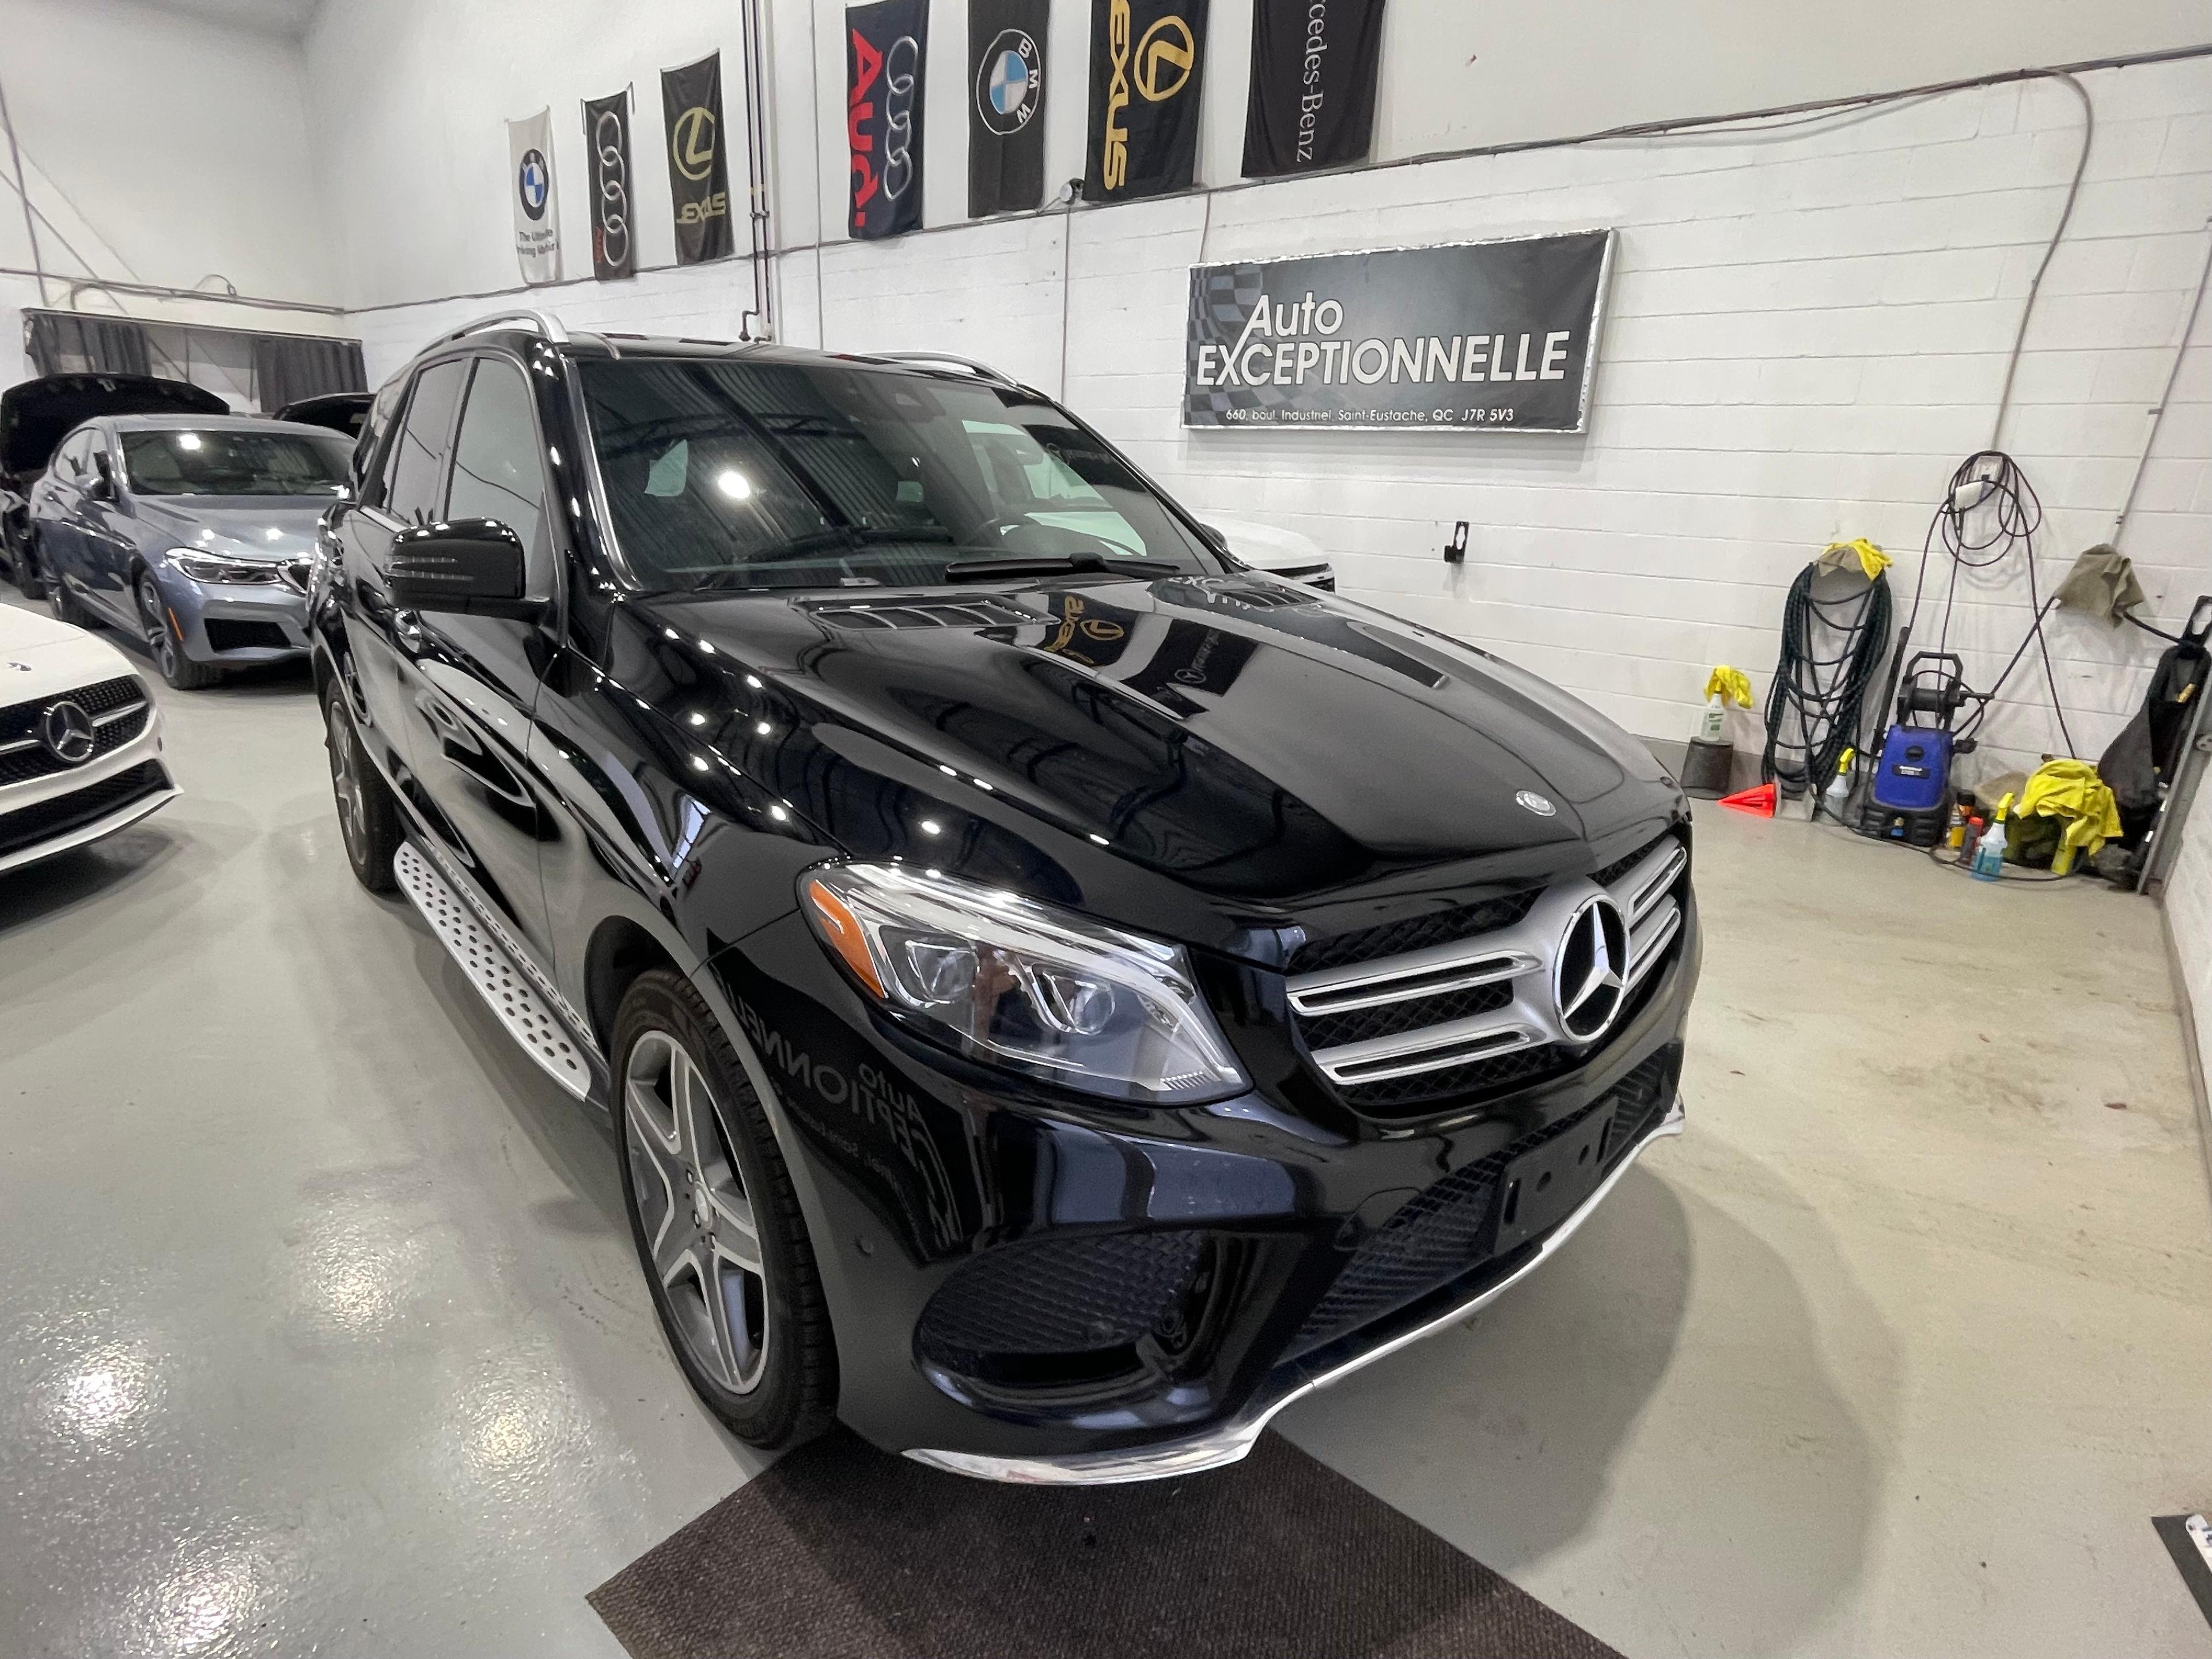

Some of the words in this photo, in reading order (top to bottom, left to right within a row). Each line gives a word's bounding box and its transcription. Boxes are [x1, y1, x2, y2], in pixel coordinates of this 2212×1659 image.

[1017, 37, 1038, 124] BMW
[1104, 0, 1130, 190] EXUS
[1297, 0, 1328, 162] cedes-Benz
[1238, 292, 1343, 344] Auto
[1196, 331, 1570, 386] EXCEPTIONNELLE
[1338, 408, 1429, 422] Saint-Eustache,
[1433, 408, 1454, 421] QC
[1461, 408, 1486, 421] J7R
[1489, 408, 1514, 422] 5V3
